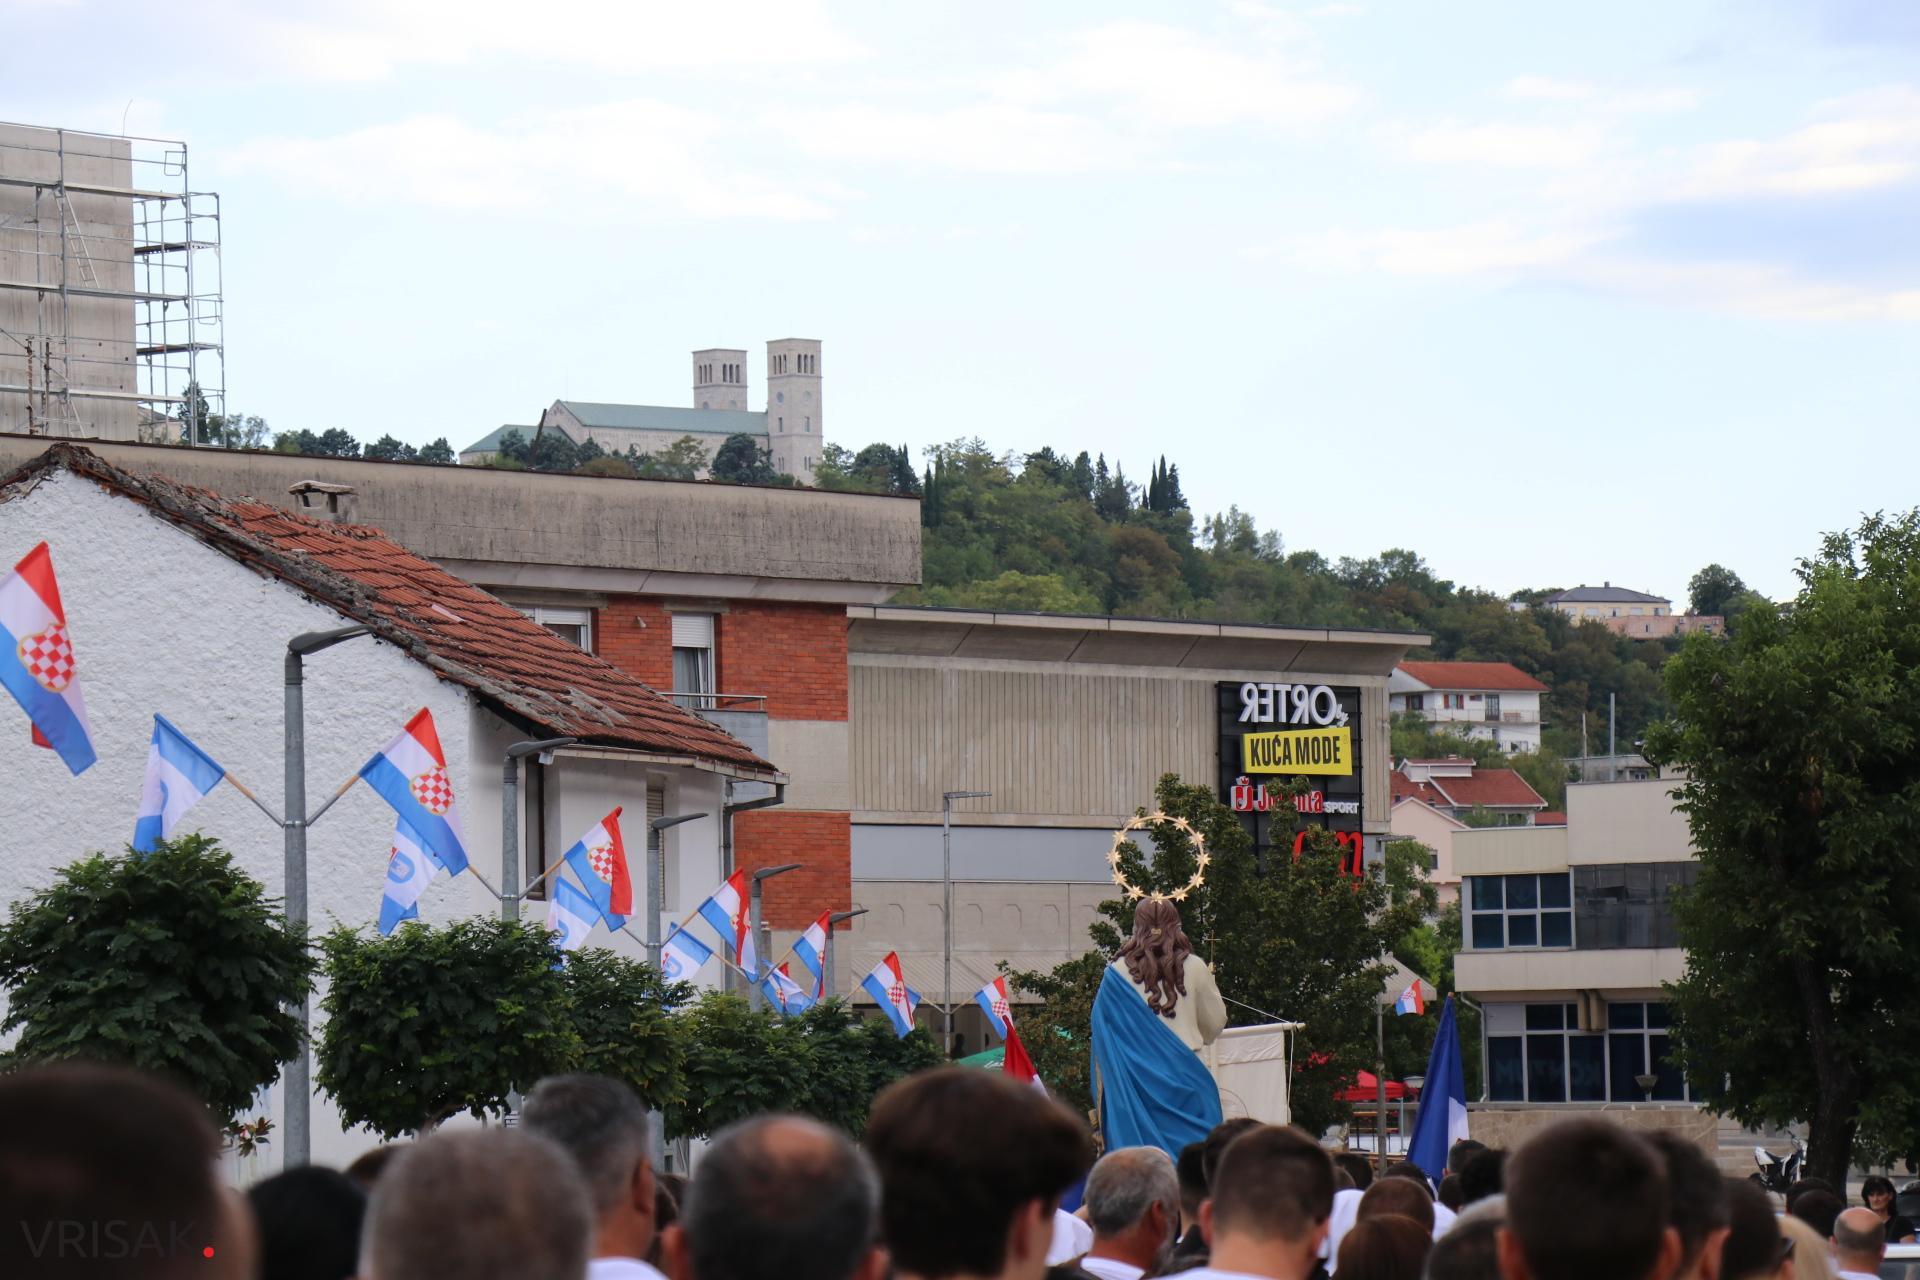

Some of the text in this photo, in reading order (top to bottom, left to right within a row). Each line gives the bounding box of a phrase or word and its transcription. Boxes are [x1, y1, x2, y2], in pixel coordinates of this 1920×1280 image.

[1250, 734, 1341, 767] KUĆA MODE
[1323, 801, 1360, 814] SPORT
